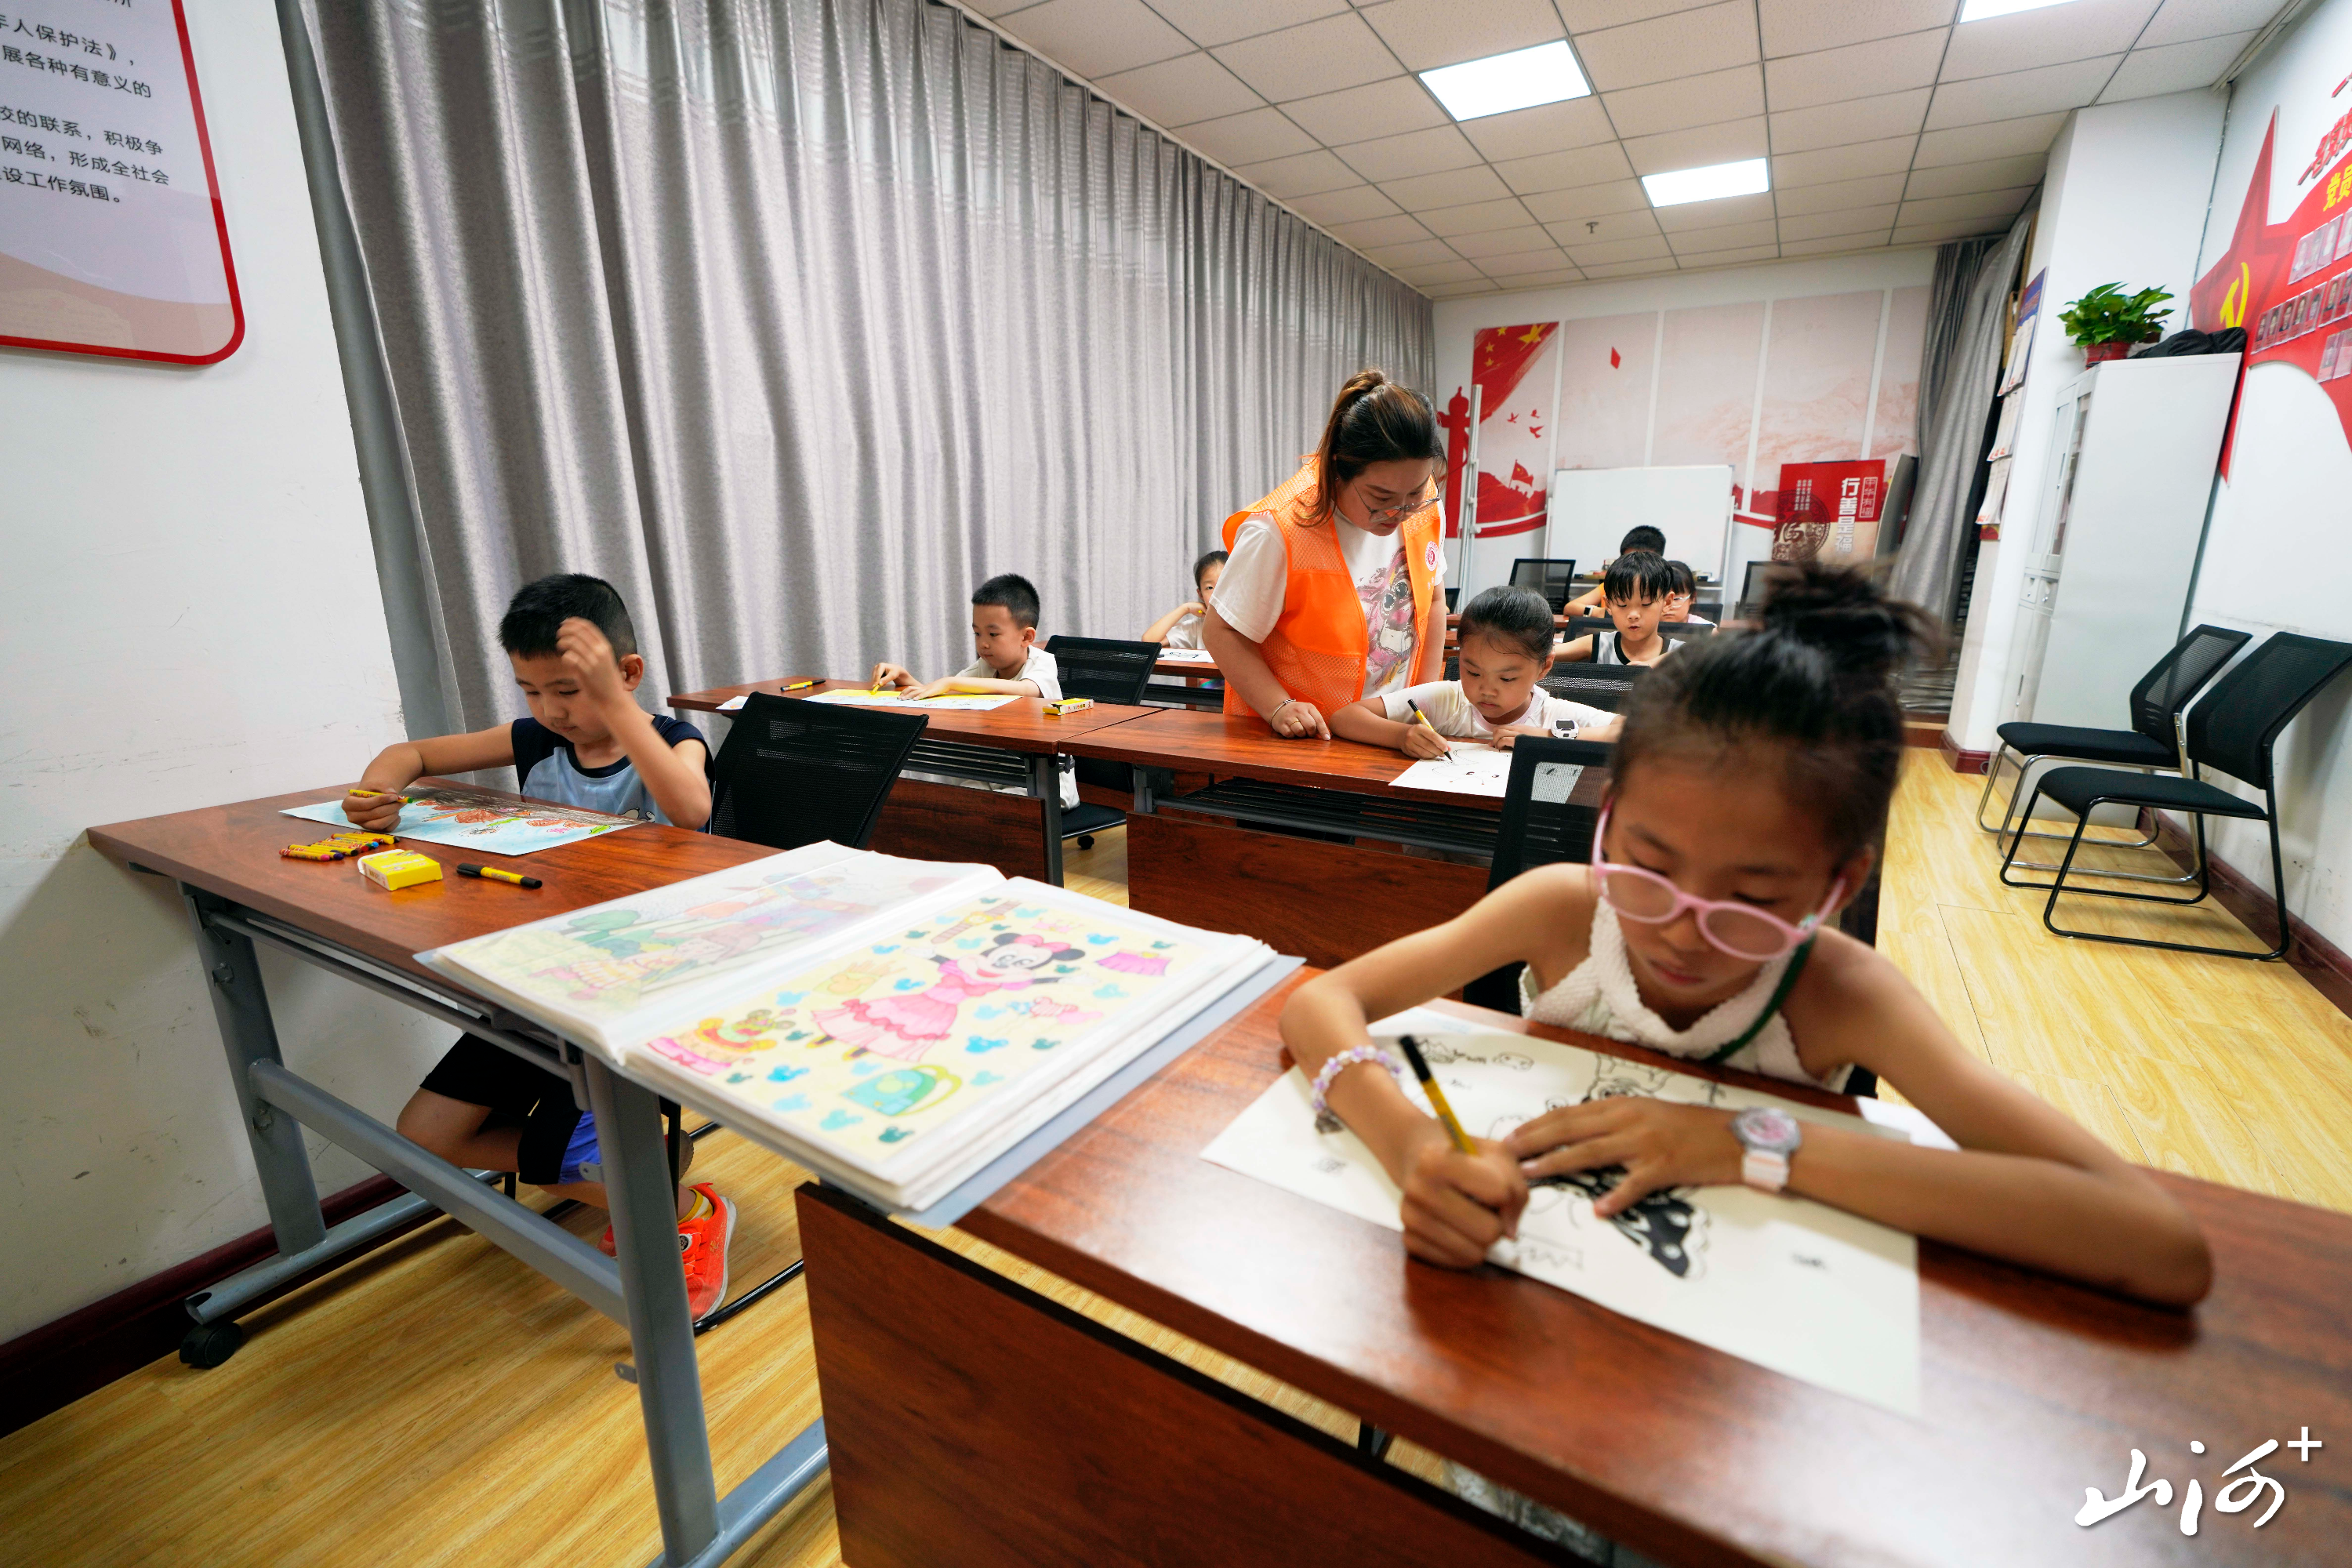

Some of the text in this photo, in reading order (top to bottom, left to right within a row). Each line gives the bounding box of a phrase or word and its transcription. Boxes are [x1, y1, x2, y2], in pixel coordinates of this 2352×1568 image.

[2, 45, 151, 98] 展各种有意义的
[0, 166, 120, 203] 设工作氛围。
[2, 136, 169, 186] 网络，形成全社会
[1835, 477, 1860, 554] 行善是福
